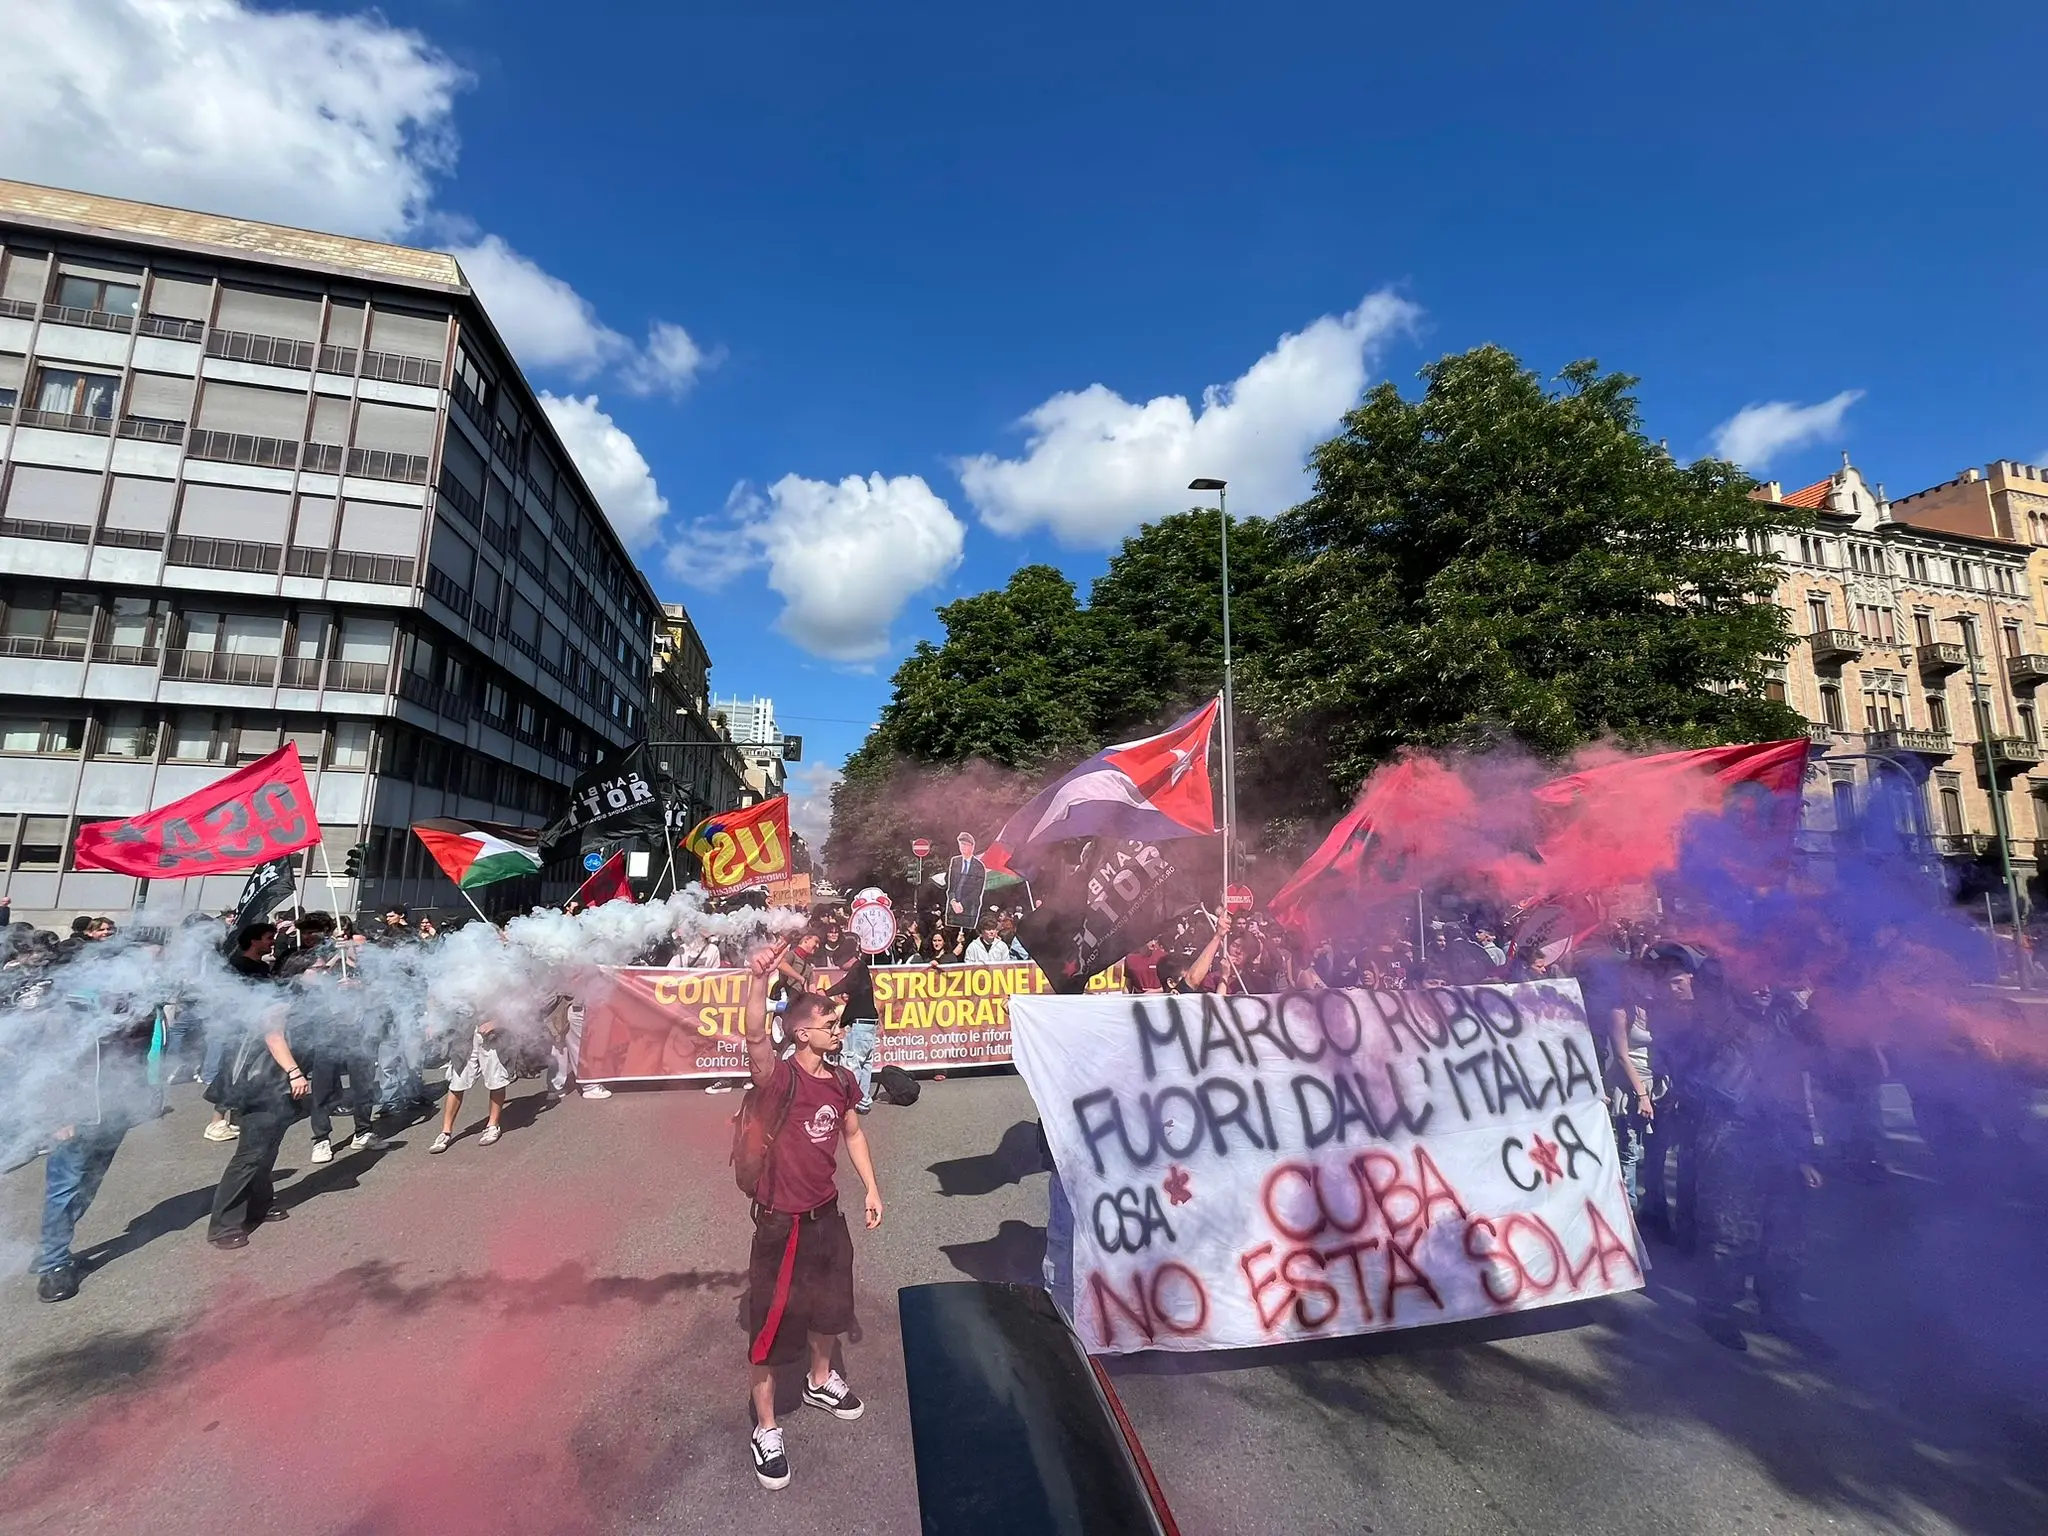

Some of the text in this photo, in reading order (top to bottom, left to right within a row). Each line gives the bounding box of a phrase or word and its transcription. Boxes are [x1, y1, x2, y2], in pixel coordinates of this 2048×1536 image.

[872, 967, 1030, 1001] STRUZIONE
[696, 1056, 739, 1068] contro
[883, 1047, 929, 1062] cultura,
[930, 1043, 968, 1059] contro
[969, 1045, 984, 1057] un
[717, 1041, 739, 1053] Per
[930, 1030, 968, 1045] contro
[969, 1029, 981, 1043] le
[1131, 988, 1362, 1082] MARCO
[1072, 1076, 1280, 1176] FUORI
[1262, 1143, 1467, 1243] CUBA
[1089, 1262, 1208, 1348] NO
[1463, 1198, 1643, 1307] SOLA
